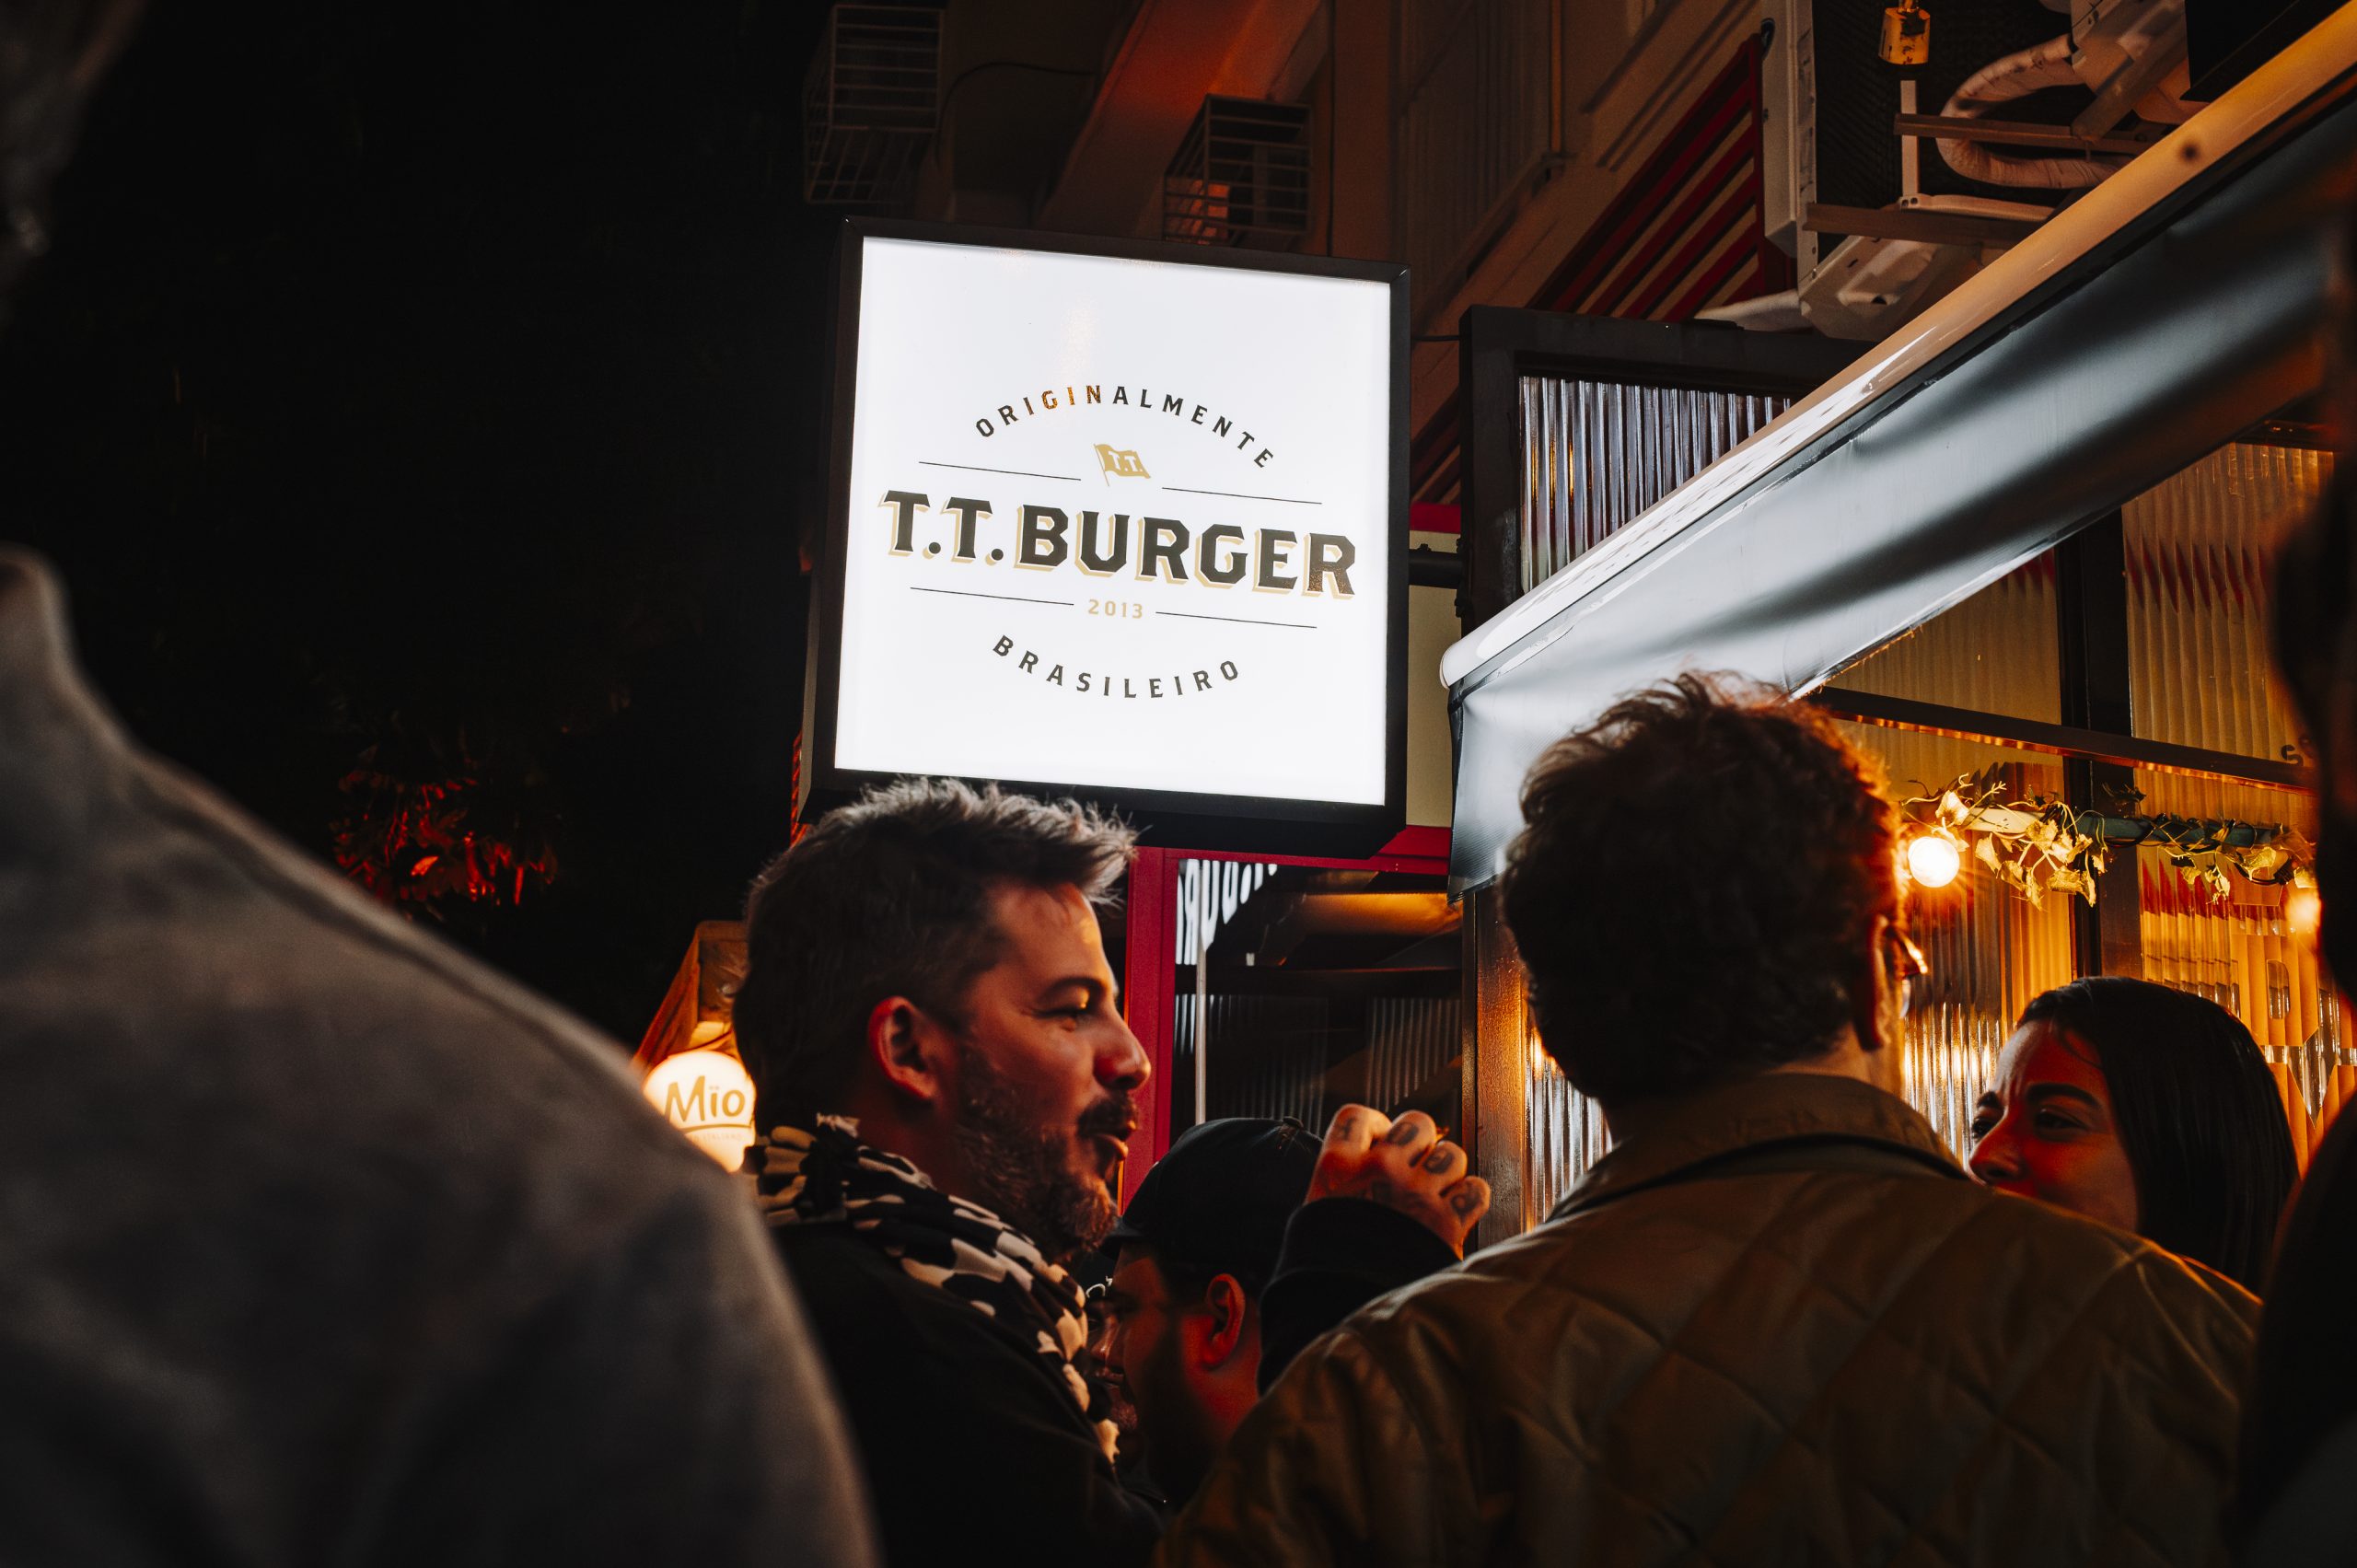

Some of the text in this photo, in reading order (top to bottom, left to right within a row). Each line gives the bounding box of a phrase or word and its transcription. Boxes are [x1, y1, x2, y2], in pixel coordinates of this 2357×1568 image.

[975, 384, 1274, 469] ORIGINALMENTE
[1108, 450, 1144, 472] T.T.
[1087, 598, 1144, 620] 2013
[992, 634, 1239, 699] BRASILEIRO
